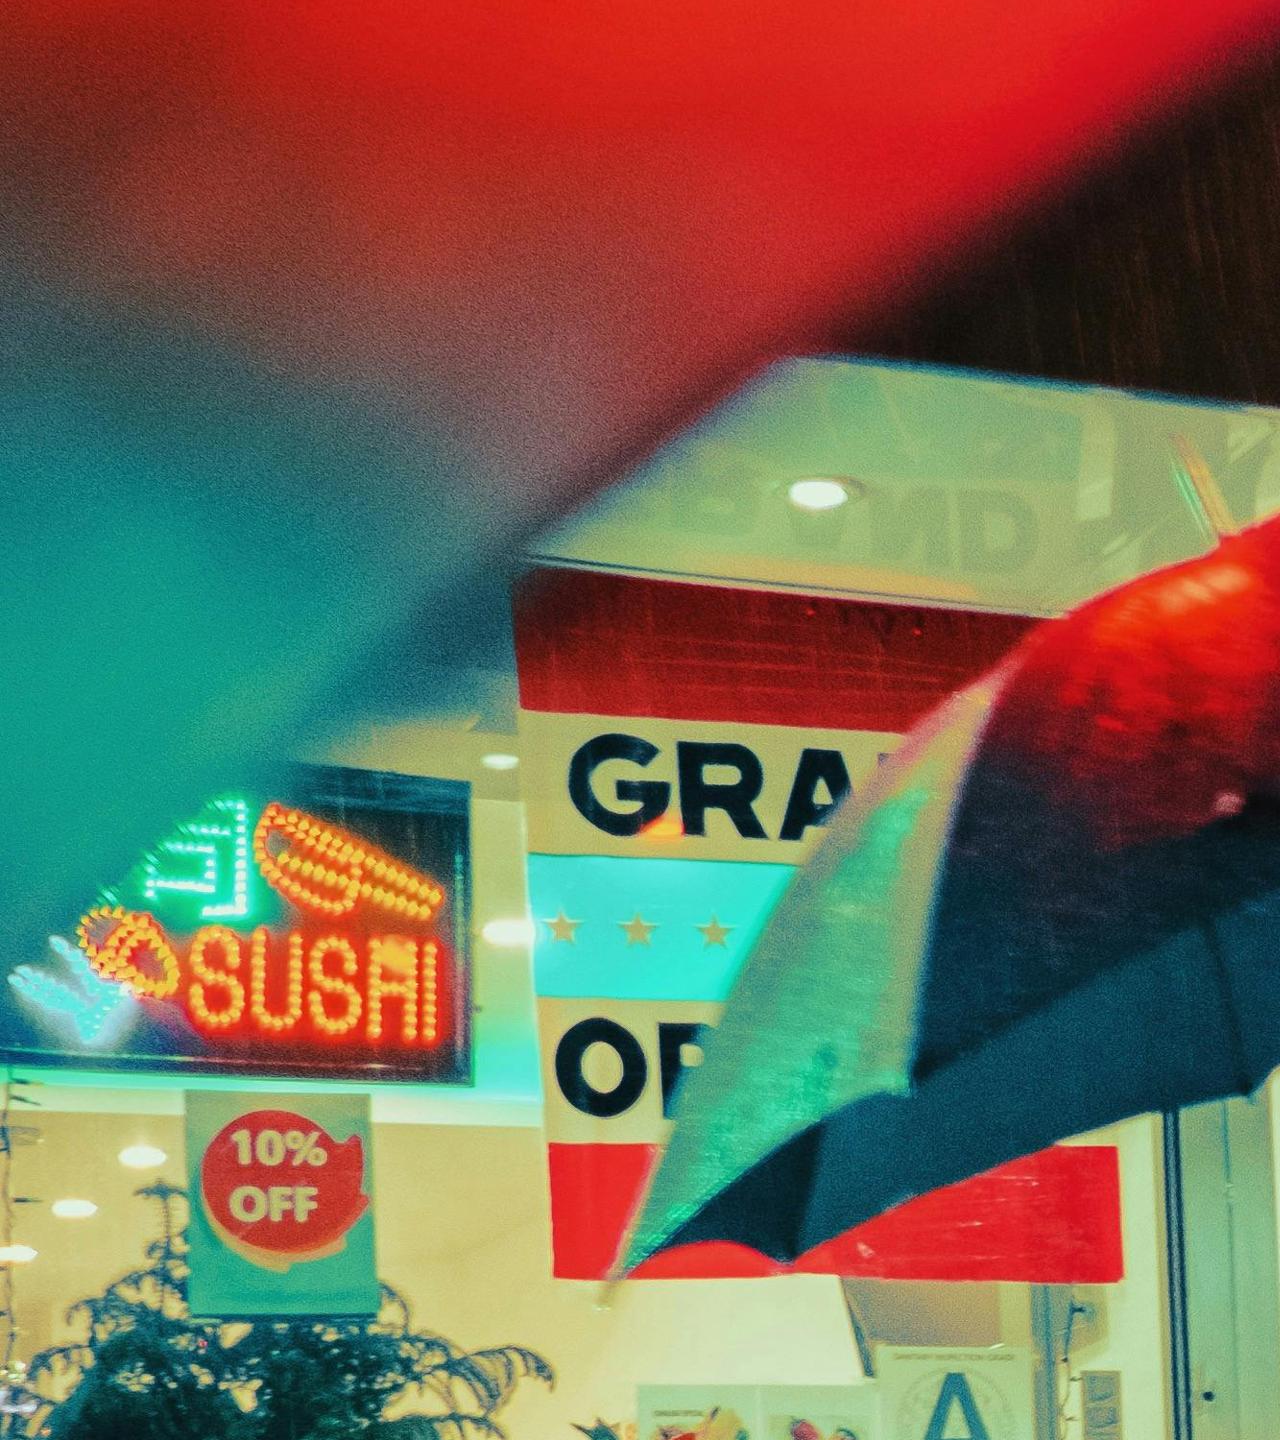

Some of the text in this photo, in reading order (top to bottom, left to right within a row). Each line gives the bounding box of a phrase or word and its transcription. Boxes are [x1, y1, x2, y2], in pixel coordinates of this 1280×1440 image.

[568, 731, 870, 841] GRA
[188, 925, 438, 1042] SUSHI
[230, 1128, 329, 1167] 10%
[229, 1185, 319, 1224] OFF
